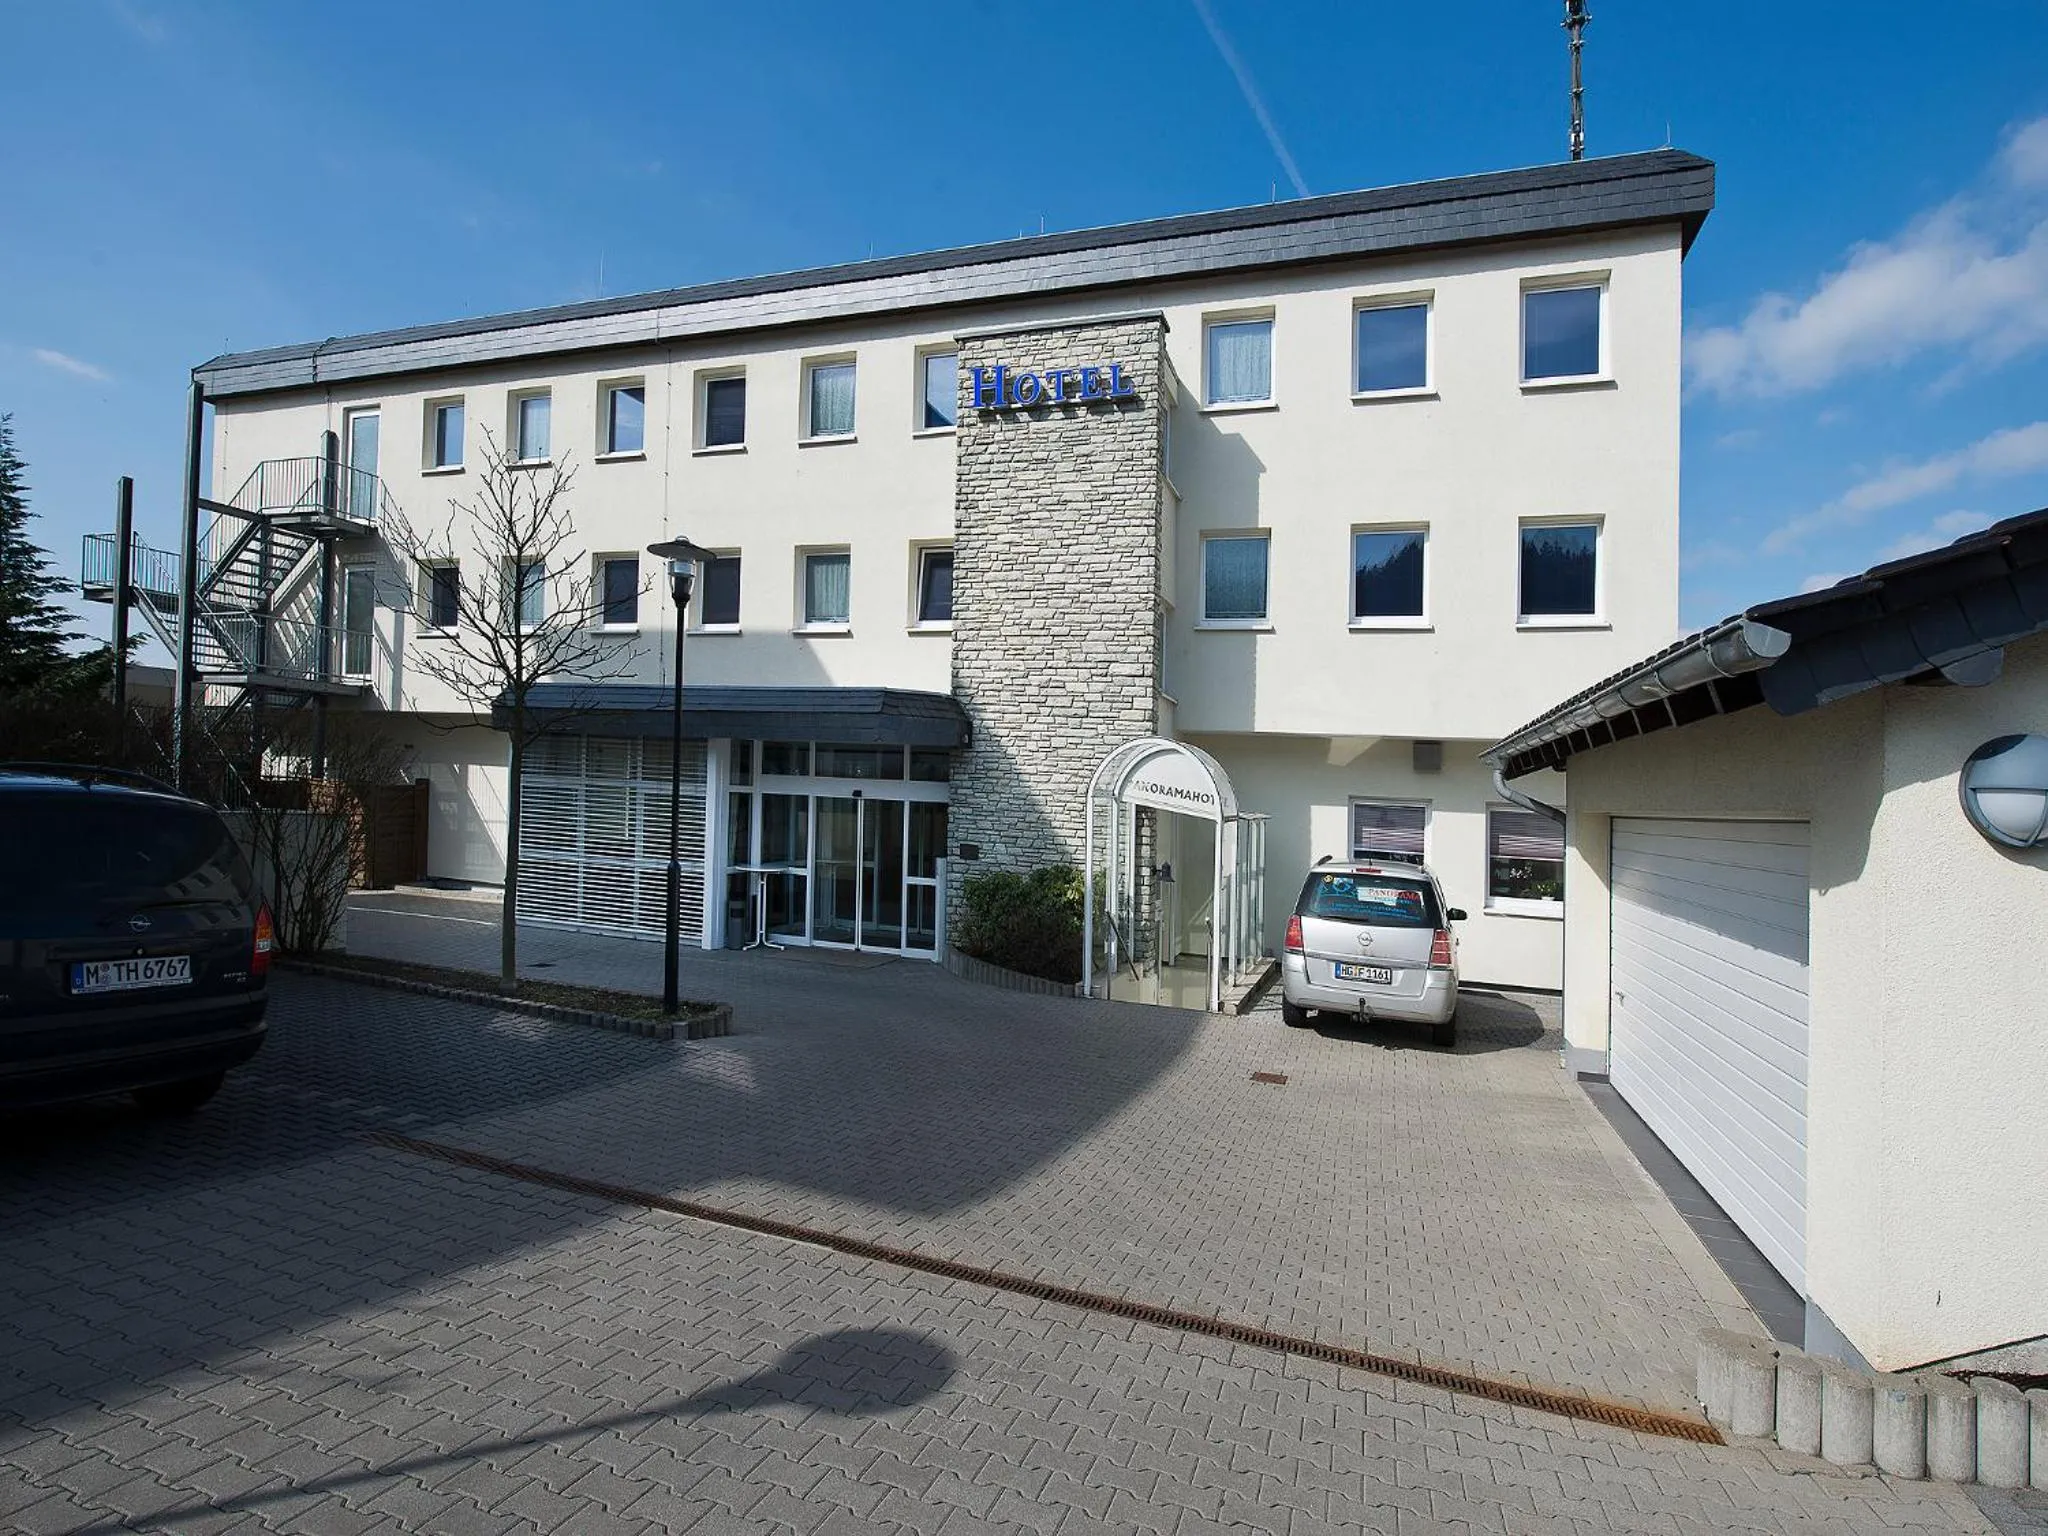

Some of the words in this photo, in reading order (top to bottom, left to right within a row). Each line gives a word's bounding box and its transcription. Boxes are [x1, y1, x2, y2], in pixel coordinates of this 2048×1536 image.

[970, 363, 1135, 408] HOTEL
[1367, 888, 1420, 901] PANORAMA
[85, 965, 99, 985] M
[113, 962, 139, 981] TH
[144, 958, 188, 979] 6767
[1341, 965, 1353, 976] HG
